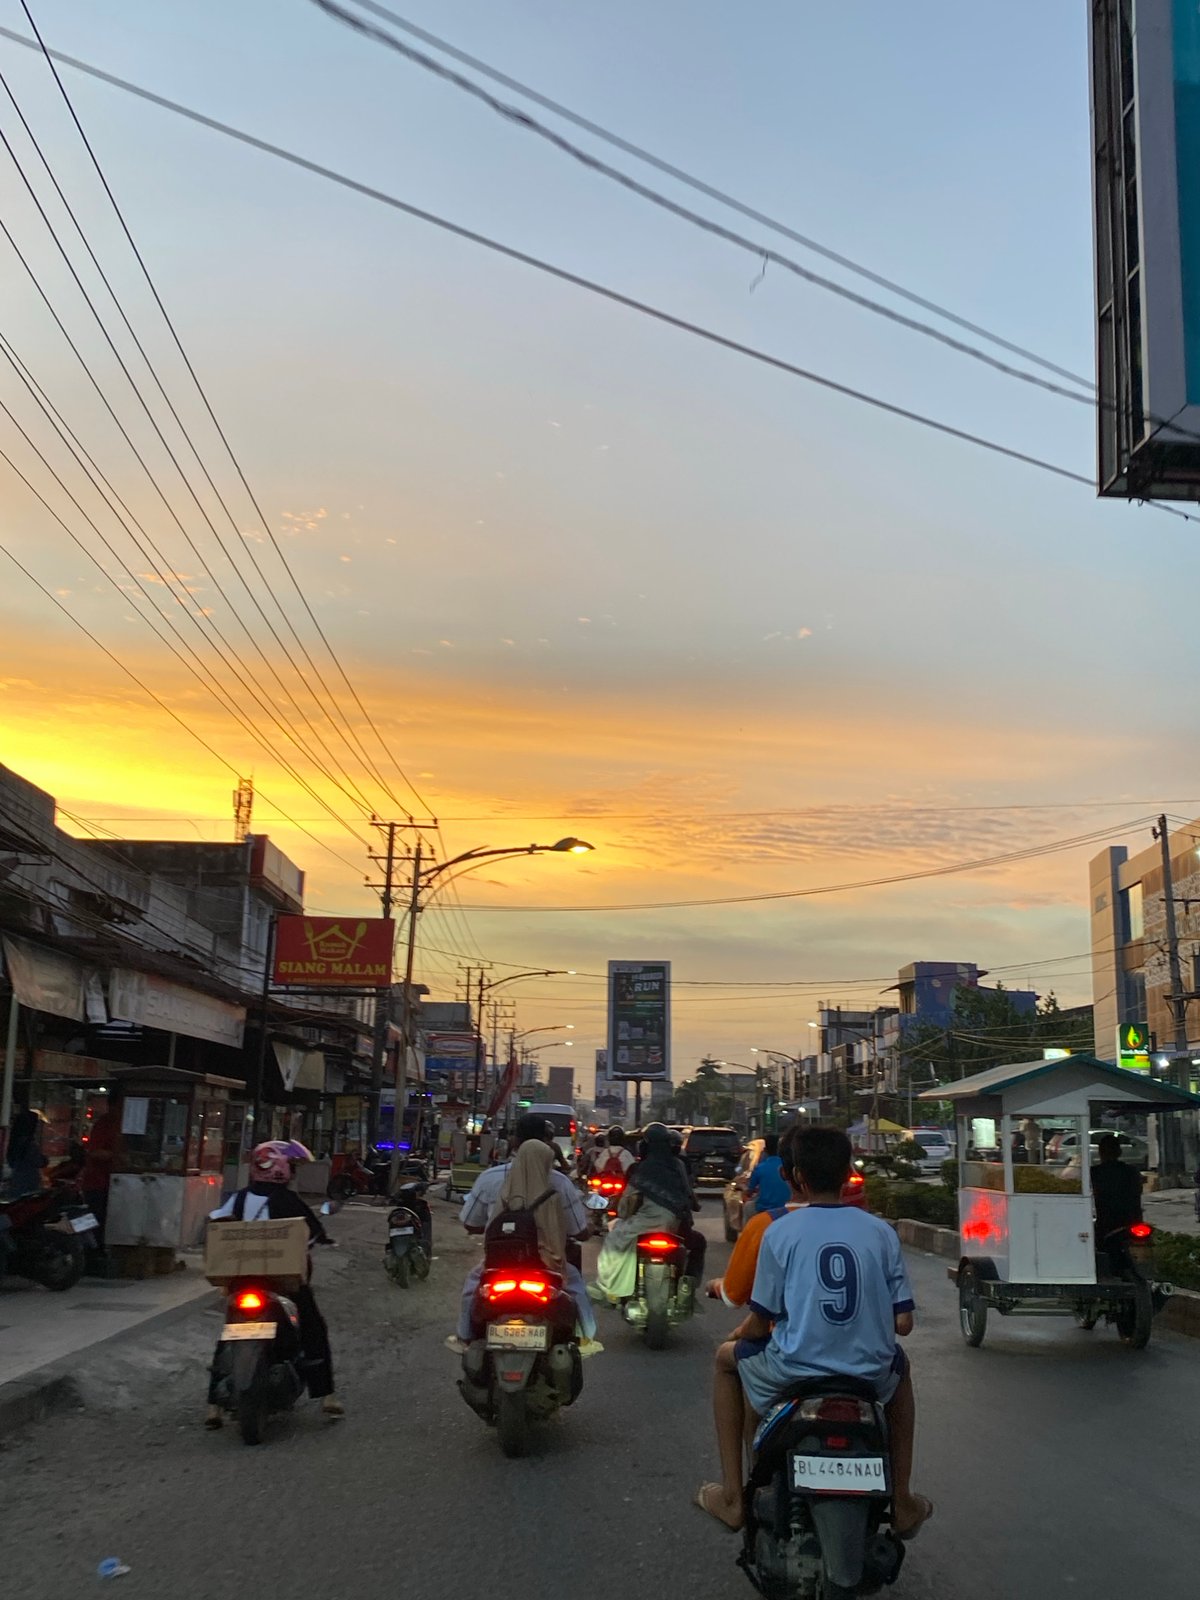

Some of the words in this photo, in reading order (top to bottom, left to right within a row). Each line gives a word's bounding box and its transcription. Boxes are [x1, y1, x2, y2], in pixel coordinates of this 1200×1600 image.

[279, 961, 327, 974] SIANG
[331, 962, 386, 975] MALAM
[635, 981, 660, 992] RUN
[816, 1241, 861, 1326] 9
